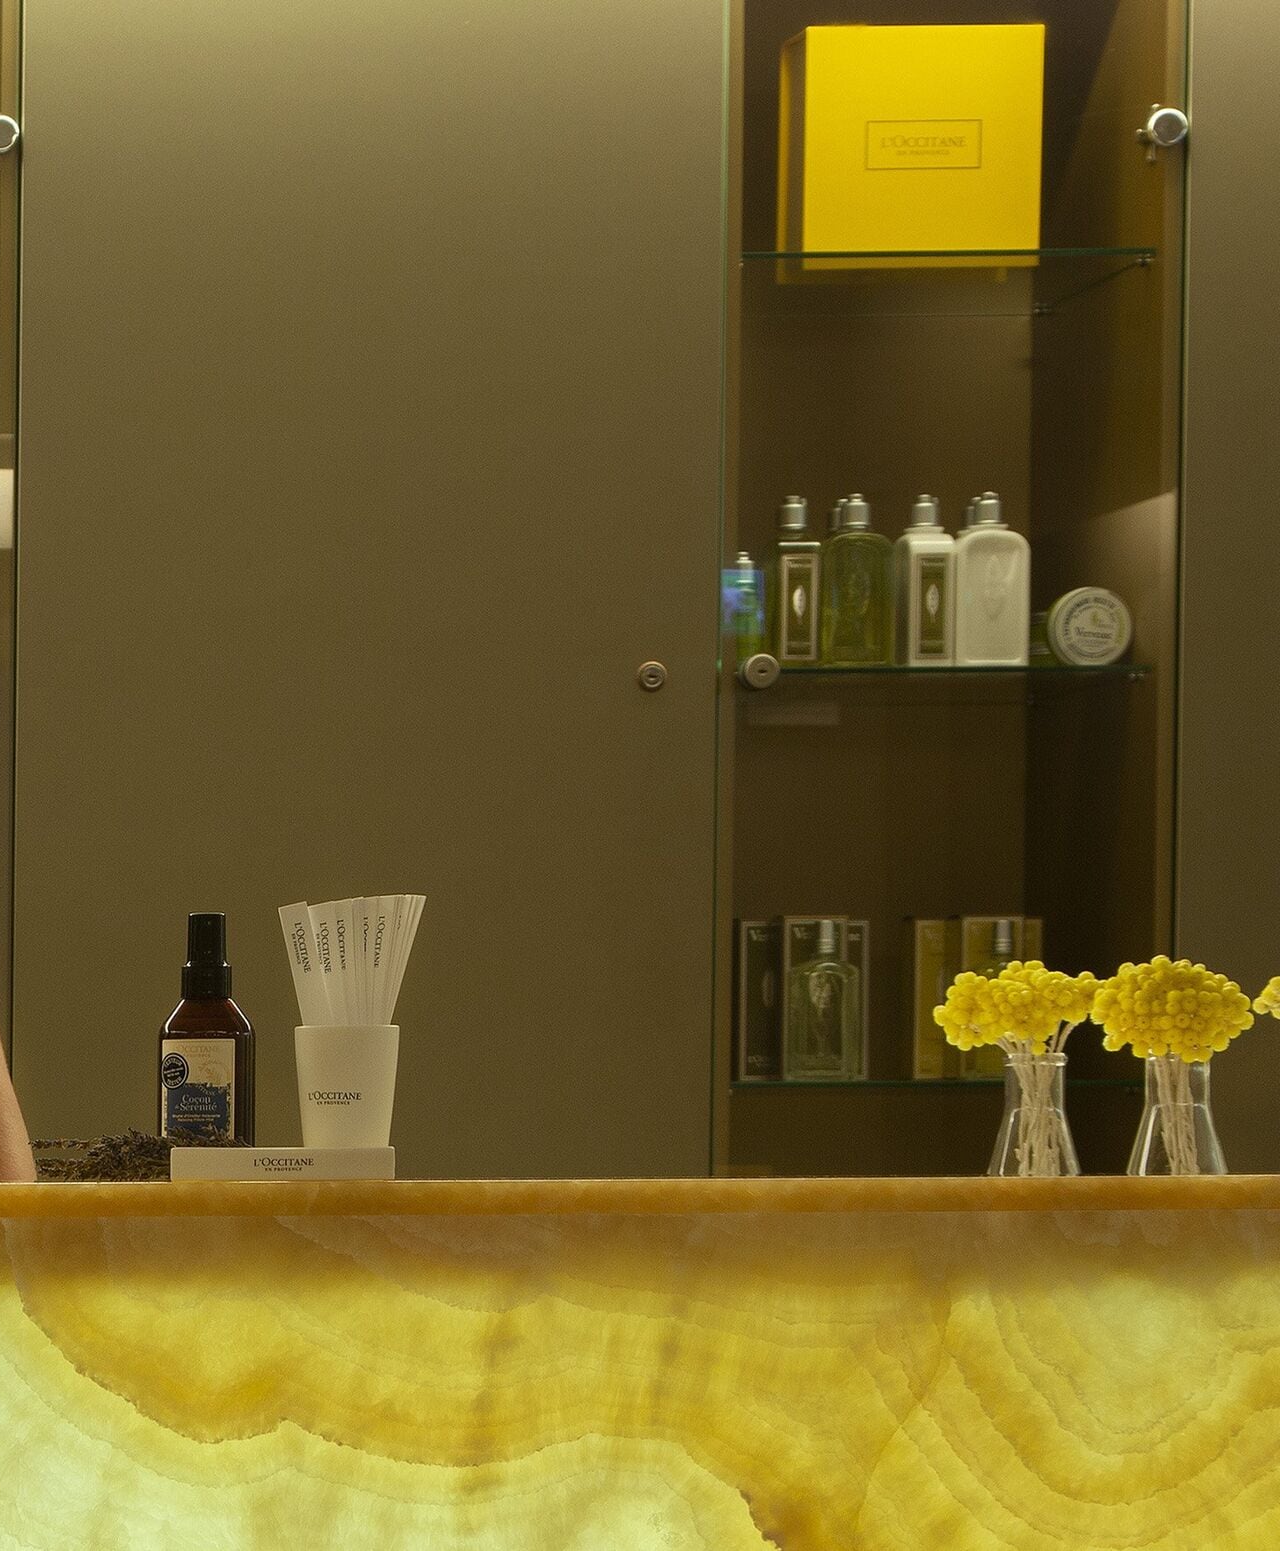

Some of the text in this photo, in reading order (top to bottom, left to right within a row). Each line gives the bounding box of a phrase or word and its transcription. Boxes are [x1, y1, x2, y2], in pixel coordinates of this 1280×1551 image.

[881, 135, 966, 148] L'OCCITANE
[295, 922, 312, 973] L'OCCITANE
[320, 921, 332, 974] L'OCCITANE
[336, 919, 346, 970] L'OCCITANE
[374, 915, 385, 968] L'OCCITANE
[308, 1091, 362, 1101] L'OCCITANE
[254, 1157, 314, 1167] L'OCCITANE
